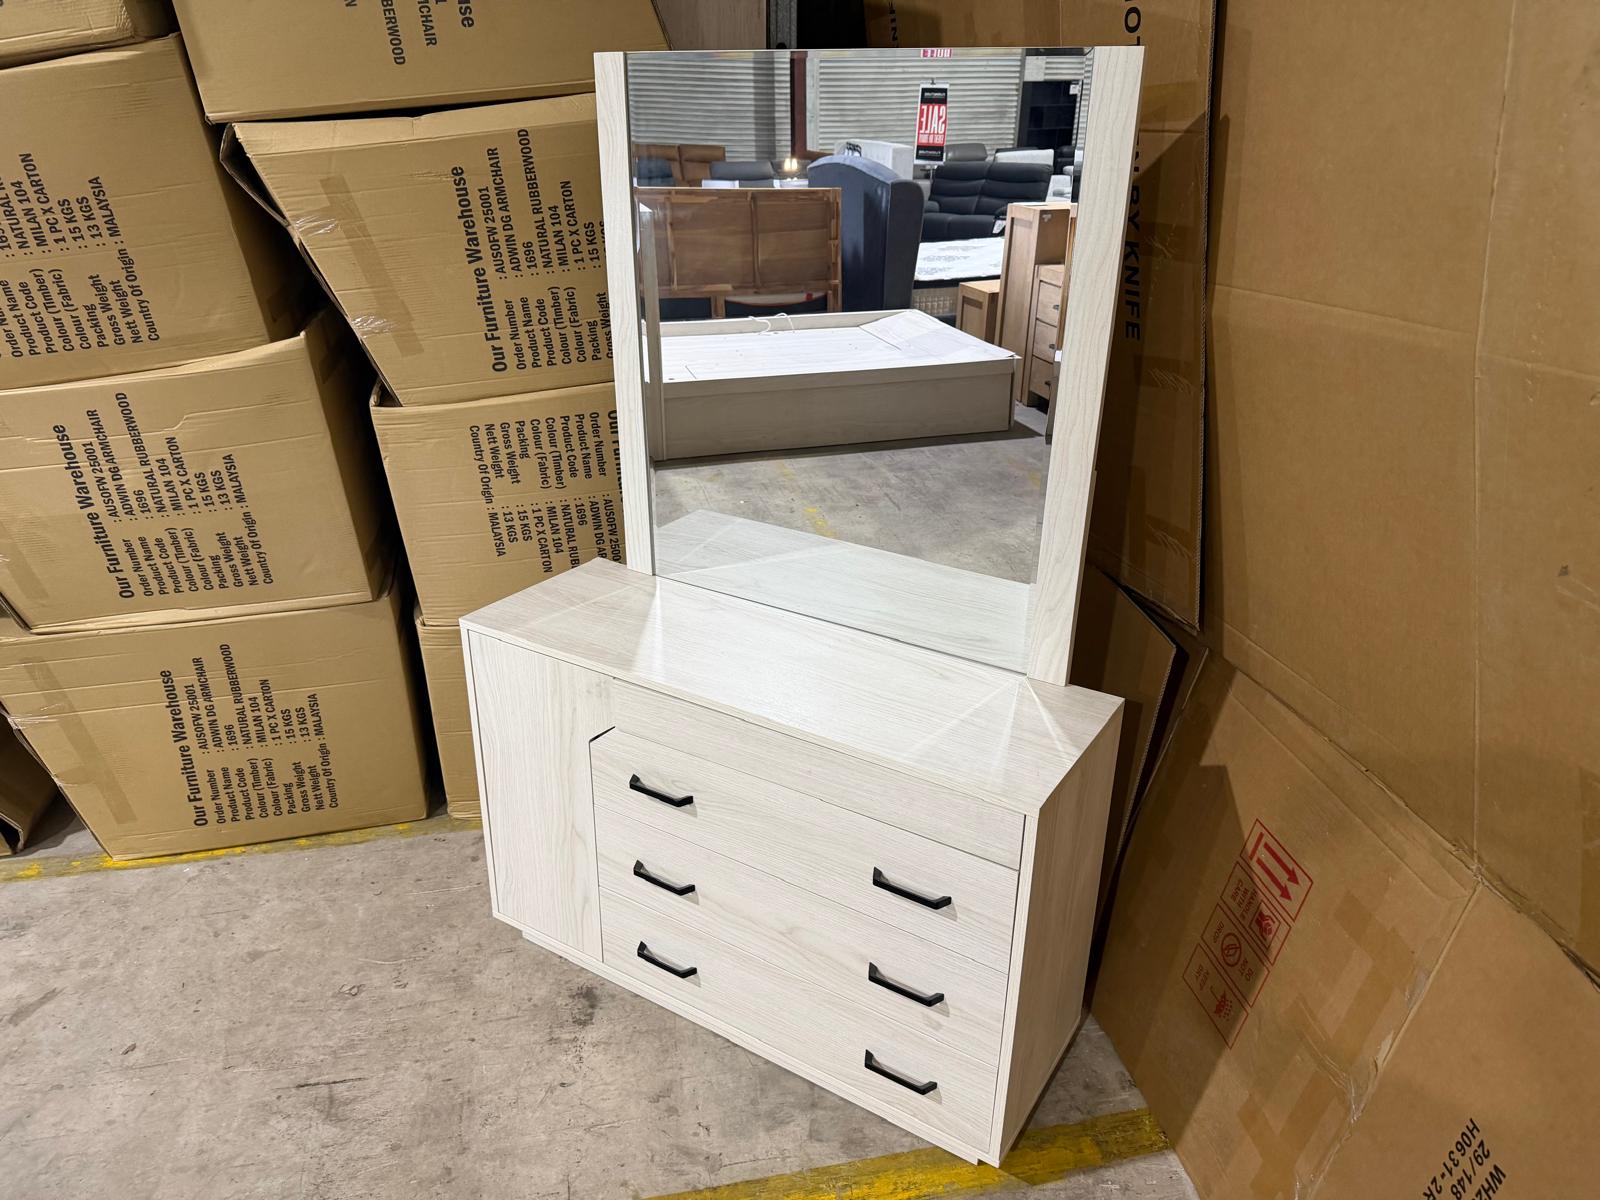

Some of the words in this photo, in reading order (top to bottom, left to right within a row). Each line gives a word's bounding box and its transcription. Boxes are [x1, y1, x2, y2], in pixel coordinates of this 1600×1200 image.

[487, 147, 510, 212] ARMCHAIR
[517, 129, 543, 215] RUBBERWOOD
[10, 180, 31, 205] 104
[88, 176, 121, 237] MALAYSIA
[478, 186, 495, 224] 25001
[22, 207, 49, 247] MILAN
[451, 166, 483, 264] Warehouse
[501, 215, 514, 231] DG
[548, 205, 561, 227] 104
[534, 216, 553, 268] NATURAL
[552, 229, 570, 266] MILAN
[584, 221, 597, 245] KGS
[117, 248, 138, 281] Origin
[486, 226, 506, 277] AUSOFW
[503, 232, 522, 273] ADWIN
[522, 241, 537, 270] 1696
[588, 248, 600, 263] 15
[29, 268, 62, 316] (Timber)
[88, 274, 113, 313] Weight
[131, 285, 143, 297] Of
[474, 267, 500, 341] Furniture
[1124, 241, 1139, 338] KNIFE
[138, 299, 160, 341] Country
[504, 299, 520, 340] Number
[520, 297, 533, 327] Name
[535, 298, 548, 325] Code
[547, 286, 567, 329] (Timber)
[563, 287, 582, 328] (Fabric)
[15, 313, 41, 356] Product
[54, 317, 74, 352] Colour
[83, 303, 109, 348] Packing
[107, 315, 126, 345] Gross
[586, 320, 602, 361] Packing
[4, 328, 23, 358] Order
[491, 345, 508, 371] Our
[514, 342, 526, 370] Order
[525, 329, 541, 368] Product
[540, 326, 557, 367] Product
[559, 332, 572, 364] Colour
[573, 331, 587, 362] Colour
[87, 409, 115, 466] ARMCHAIR
[115, 392, 149, 467] RUBBERWOOD
[515, 421, 529, 459] Packing
[545, 417, 557, 449] Colour
[575, 413, 587, 451] Product
[589, 412, 600, 438] Order
[82, 441, 102, 474] 25001
[469, 425, 484, 461] Country
[500, 422, 512, 449] Gross
[506, 451, 520, 484] Weight
[594, 440, 606, 477] Number
[53, 424, 94, 509] Warehouse
[108, 466, 123, 481] DG
[155, 458, 172, 477] 104
[222, 454, 247, 505] MALAYSIA
[478, 464, 490, 474] Of
[549, 450, 567, 490] (Timber)
[581, 452, 592, 480] Name
[94, 475, 120, 517] AUSOFW
[114, 482, 136, 516] ADWIN
[133, 489, 152, 515] 1696
[143, 468, 168, 513] NATURAL
[163, 480, 183, 511] MILAN
[480, 476, 494, 504] Origin
[242, 511, 258, 538] Origin
[546, 505, 560, 534] MILAN
[561, 504, 577, 544] NATURAL
[575, 502, 587, 526] 1696
[589, 500, 601, 532] ADWIN
[87, 512, 123, 575] Furniture
[138, 536, 155, 562] Name
[154, 537, 169, 559] Code
[164, 527, 189, 565] (Timber)
[181, 528, 205, 561] (Fabric)
[216, 532, 234, 563] Weight
[251, 541, 262, 550] Of
[488, 512, 506, 557] MALAYSIA
[552, 538, 564, 553] 104
[594, 533, 605, 547] DG
[122, 539, 143, 573] Number
[233, 536, 252, 567] Weight
[609, 538, 622, 563] 2500
[148, 563, 169, 595] Product
[163, 561, 184, 593] Product
[182, 564, 199, 592] Colour
[198, 563, 214, 591] Colour
[209, 555, 229, 589] Packing
[229, 564, 244, 587] Gross
[243, 568, 259, 586] Nett
[257, 552, 274, 584] Country
[116, 575, 134, 598] Our
[139, 574, 154, 596] Order
[192, 656, 213, 703] ARMCHAIR
[220, 644, 244, 704] RUBBERWOOD
[160, 670, 188, 744] Warehouse
[184, 683, 200, 713] 25001
[204, 704, 216, 718] DG
[248, 696, 260, 713] 104
[235, 705, 252, 745] NATURAL
[253, 715, 268, 743] MILAN
[281, 708, 293, 728] KGS
[295, 707, 308, 726] KGS
[307, 693, 325, 737] MALAYSIA
[191, 714, 208, 750] AUSOFW
[208, 720, 223, 748] ADWIN
[224, 724, 238, 747] 1696
[284, 728, 296, 739] 15
[299, 727, 310, 738] 13
[317, 742, 330, 767] Origin
[179, 745, 202, 803] Furniture
[206, 769, 220, 801] Number
[221, 767, 233, 791] Name
[236, 767, 247, 788] Code
[247, 757, 264, 791] (Timber)
[261, 757, 279, 789] (Fabric)
[292, 761, 306, 789] Weight
[307, 765, 321, 794] Weight
[322, 768, 332, 776] Of
[226, 791, 240, 822] Product
[239, 791, 255, 821] Product
[256, 793, 269, 818] Colour
[270, 790, 283, 816] Colour
[283, 782, 297, 815] Packing
[300, 790, 311, 813] Gross
[311, 794, 325, 810] Nett
[324, 777, 338, 808] Country
[193, 806, 208, 826] Our
[214, 803, 226, 824] Order
[1450, 1139, 1490, 1200] 29/148
